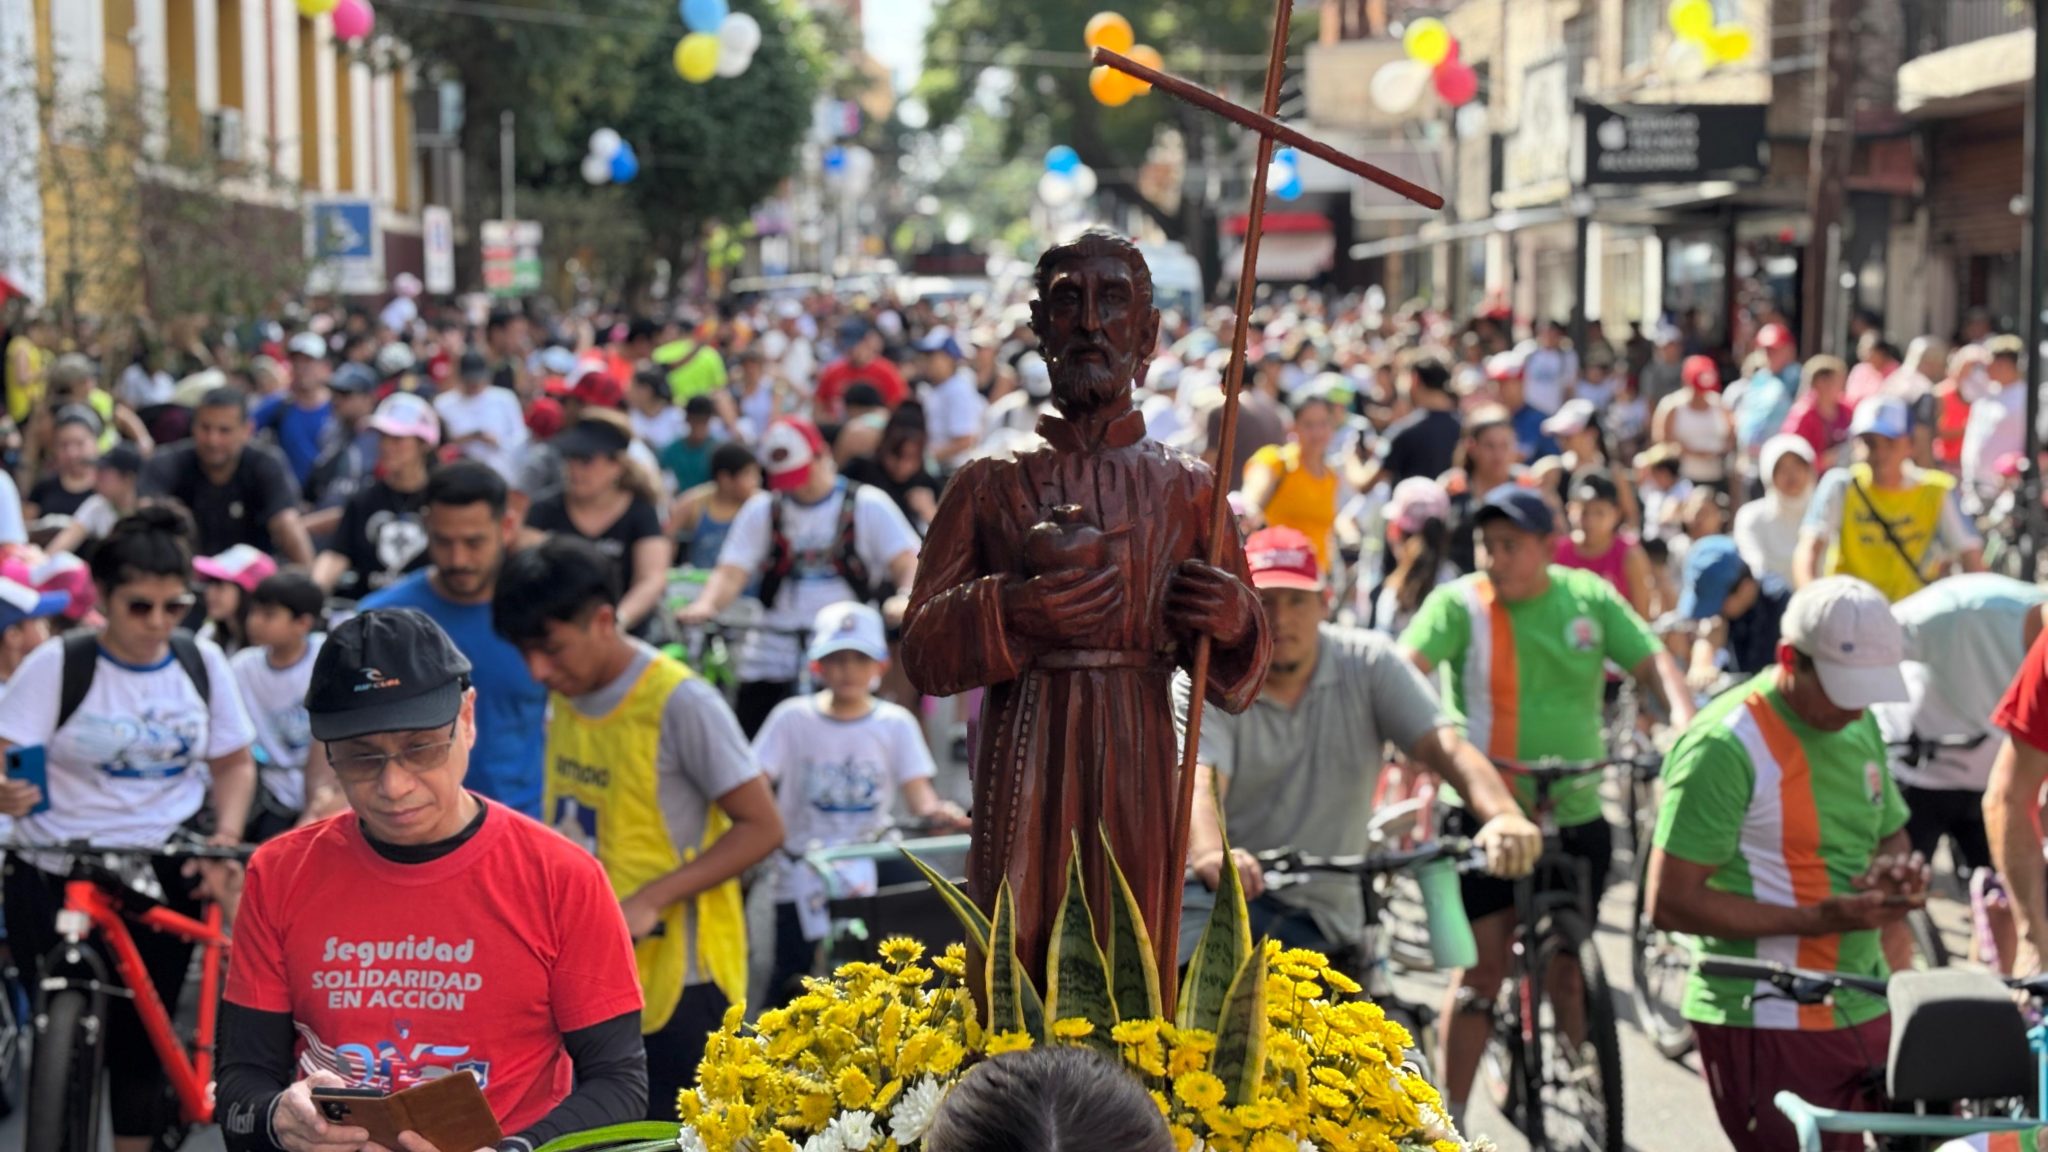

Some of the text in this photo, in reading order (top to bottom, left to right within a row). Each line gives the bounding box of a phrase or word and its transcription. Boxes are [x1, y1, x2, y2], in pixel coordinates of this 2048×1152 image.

[322, 934, 475, 968] Seguridad
[312, 969, 482, 991] SOLIDARIDAD
[328, 987, 465, 1011] EN ACCIÓN
